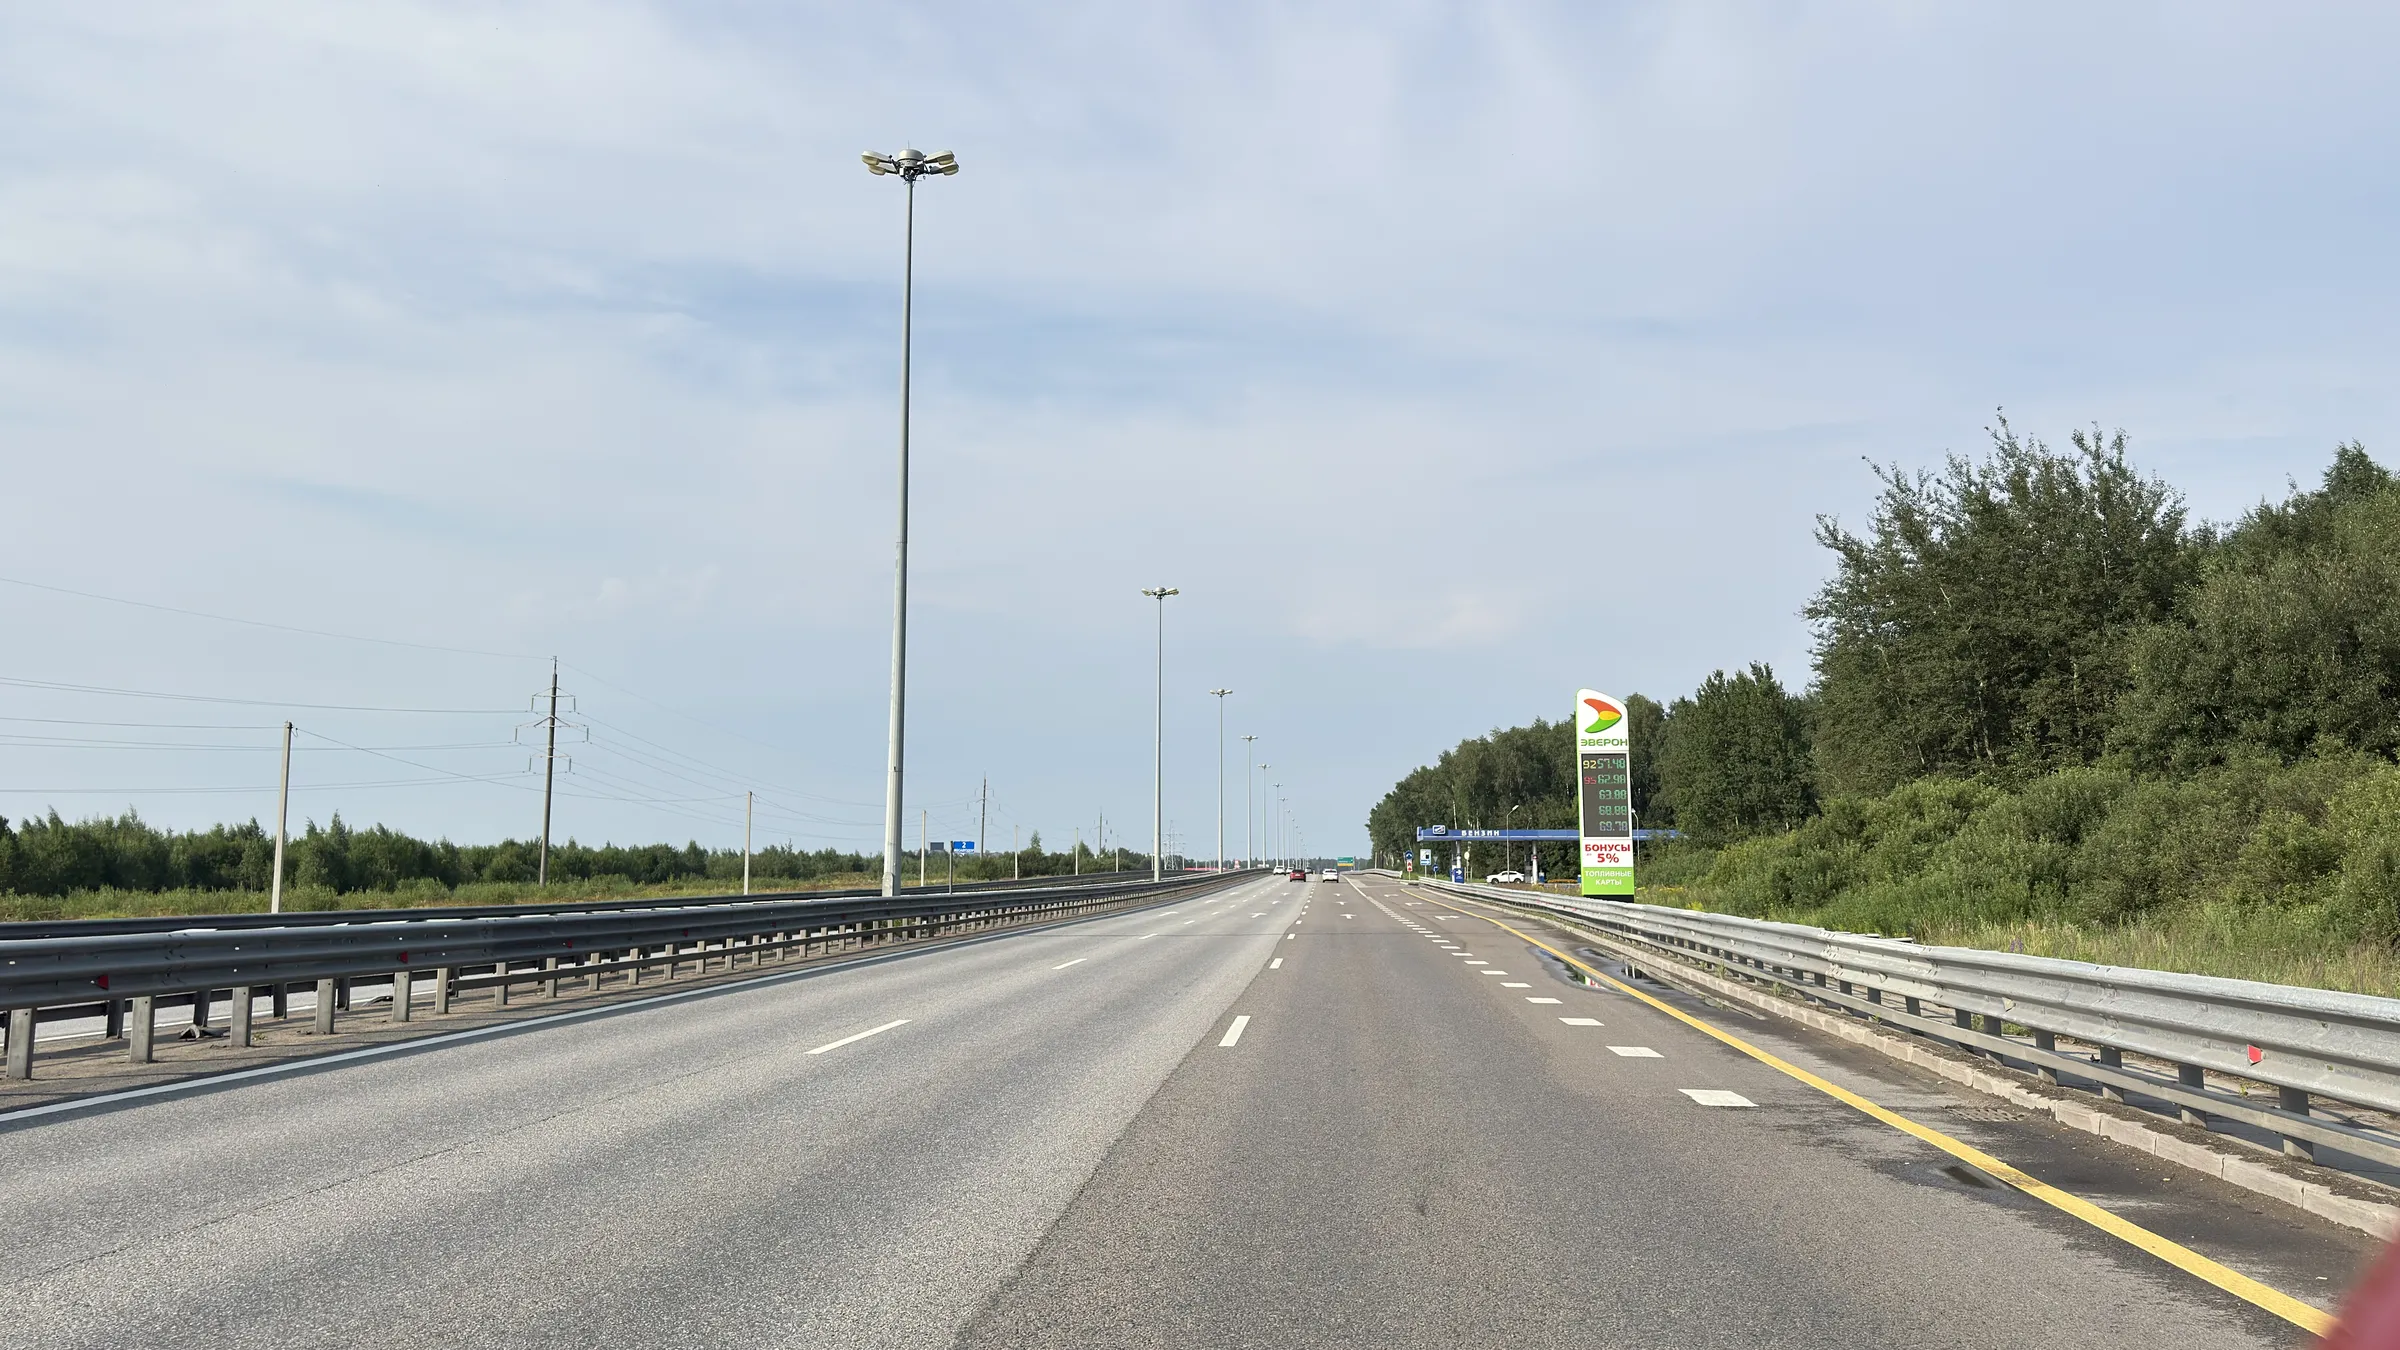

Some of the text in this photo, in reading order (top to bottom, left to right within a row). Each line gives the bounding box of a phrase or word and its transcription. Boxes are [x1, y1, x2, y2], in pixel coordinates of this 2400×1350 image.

[1581, 738, 1627, 746] ЭВЕРОН
[1583, 760, 1596, 769] 92
[1584, 776, 1596, 785] 95
[1585, 844, 1630, 852] БОНУСЫ
[1597, 853, 1619, 863] 5%
